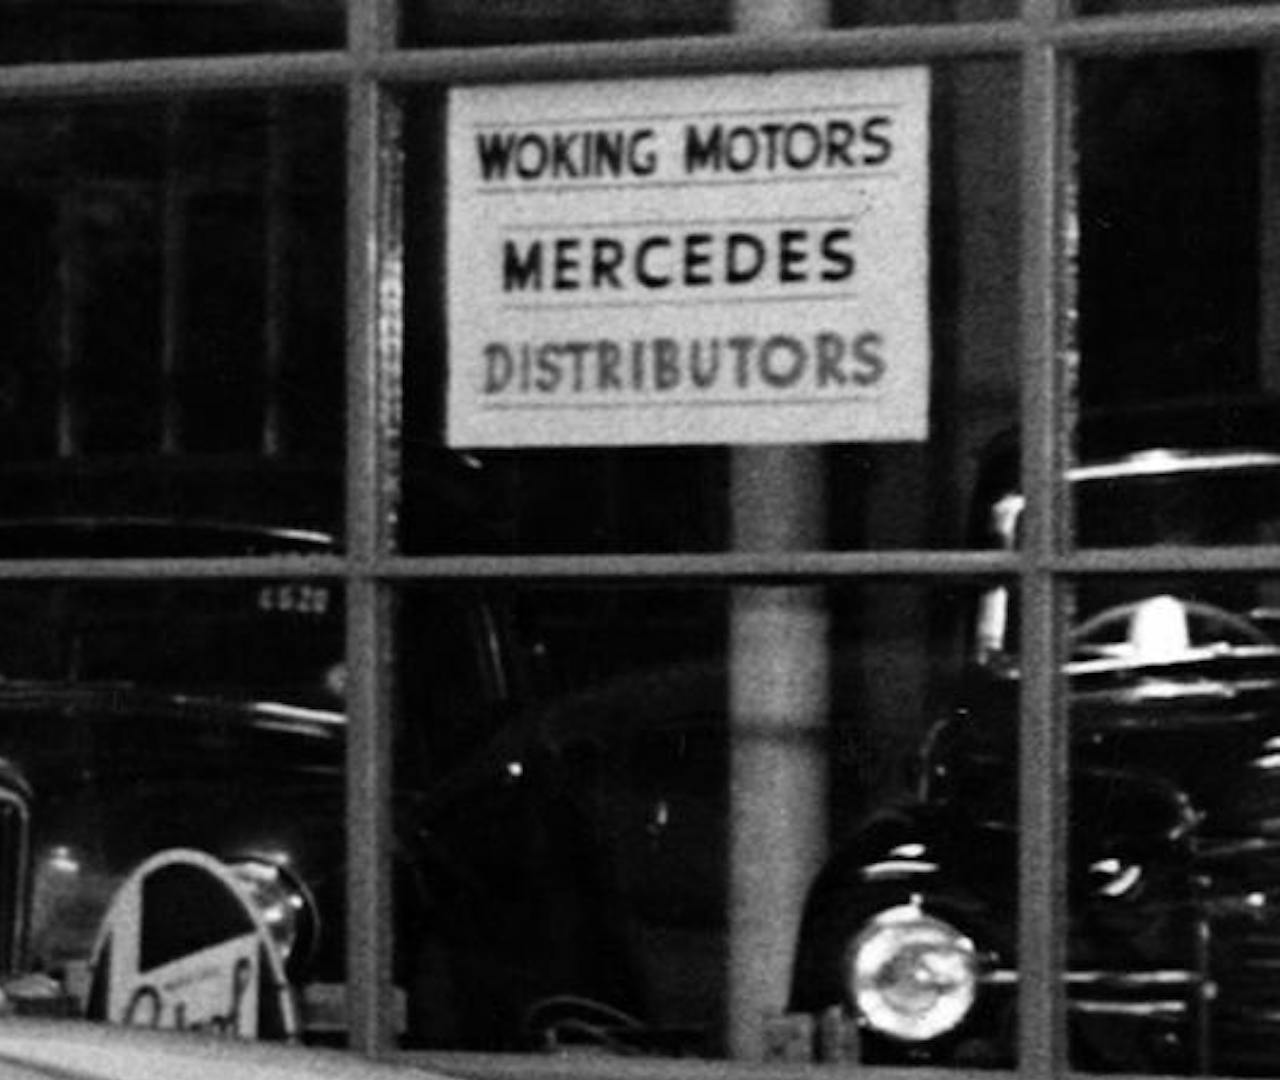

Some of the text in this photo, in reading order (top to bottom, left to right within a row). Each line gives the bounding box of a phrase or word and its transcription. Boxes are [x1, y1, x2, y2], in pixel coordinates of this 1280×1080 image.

[476, 115, 893, 182] WOKING MOTORS
[501, 227, 856, 293] MERCEDES
[481, 330, 887, 396] DISTRIBUTORS
